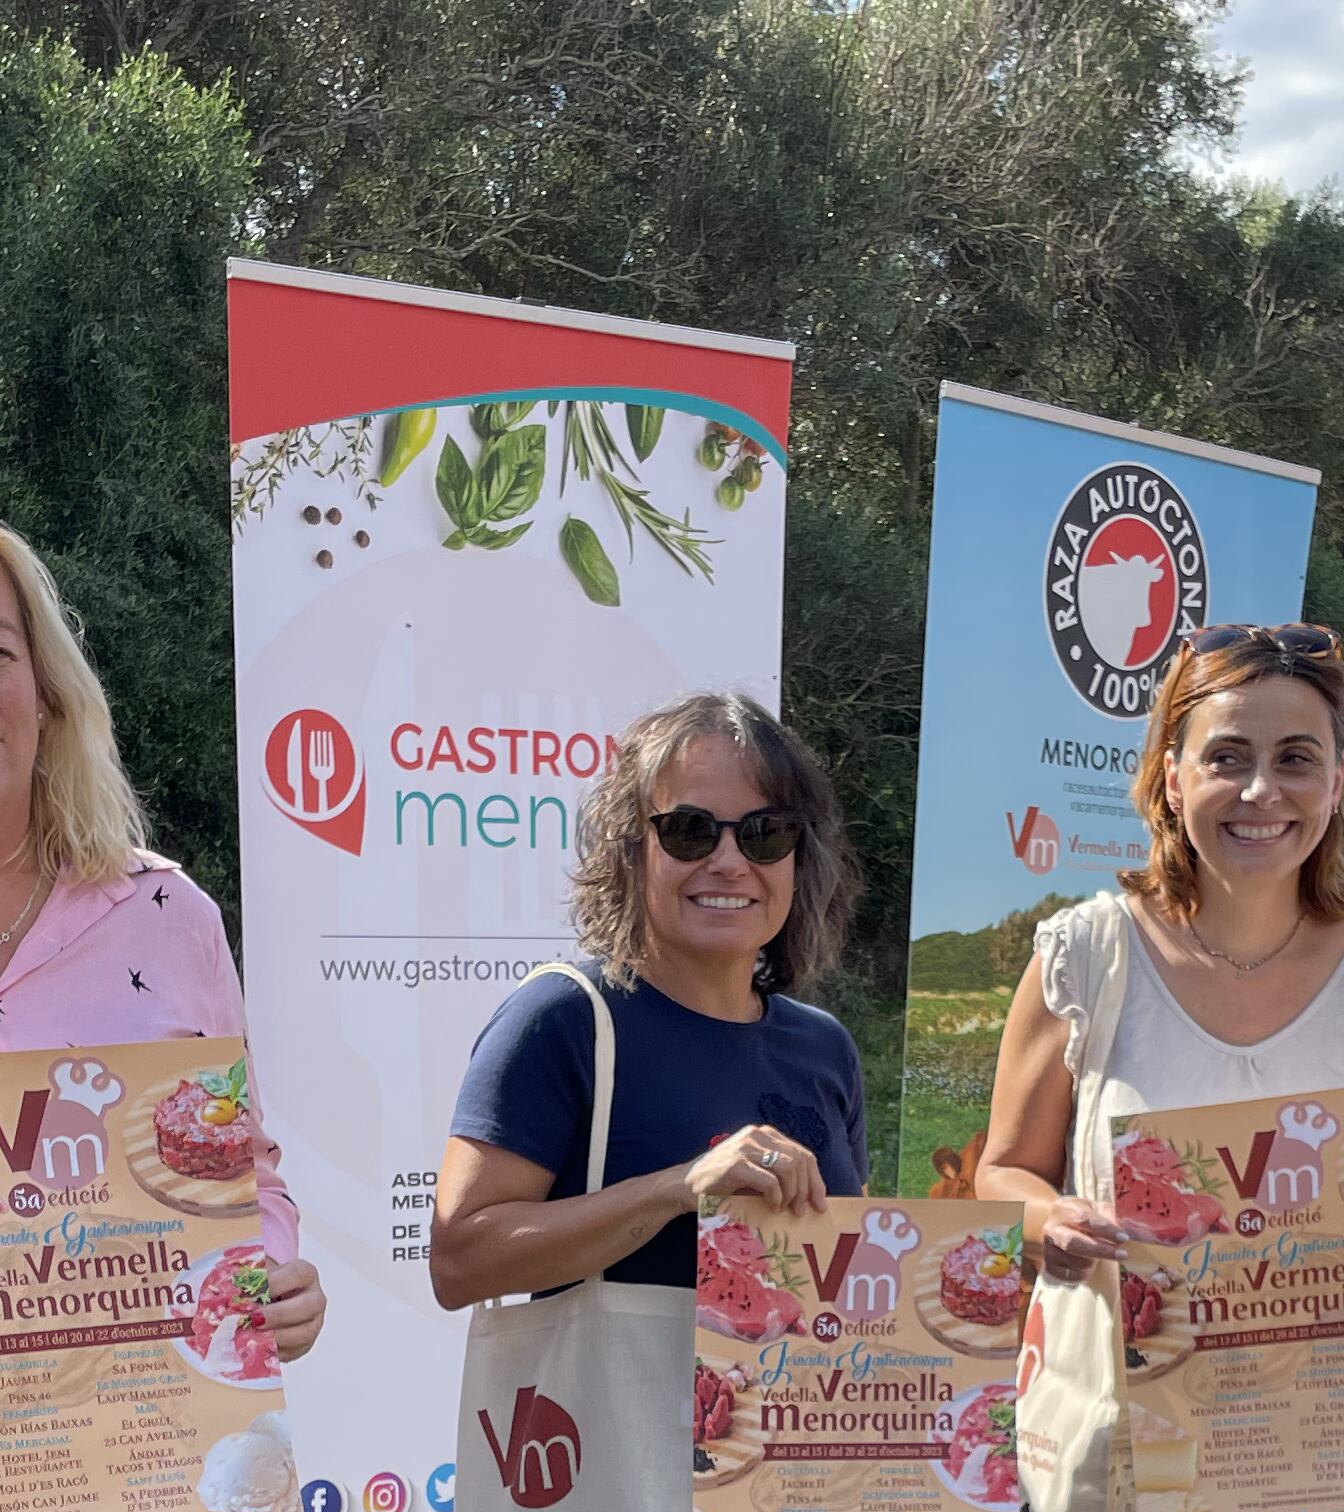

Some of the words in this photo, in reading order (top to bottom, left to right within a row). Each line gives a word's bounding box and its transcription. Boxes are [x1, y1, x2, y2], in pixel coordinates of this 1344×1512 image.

[1051, 522, 1089, 632] RAZA
[1088, 662, 1157, 712] 100%
[391, 723, 618, 779] GASTRO
[1040, 738, 1139, 775] MENORQ
[395, 790, 568, 850] men
[392, 1171, 437, 1188] ASO
[48, 1181, 113, 1207] edició
[392, 1194, 436, 1210] MEN
[1267, 1205, 1322, 1228] edició
[392, 1224, 421, 1240] DE
[23, 1240, 191, 1284] Vermella
[392, 1245, 431, 1262] RES
[1187, 1280, 1245, 1298] Vedella
[845, 1318, 897, 1336] edició
[761, 1387, 818, 1402] Vedella
[817, 1370, 954, 1401] Vermella
[1017, 1430, 1059, 1454] orquina
